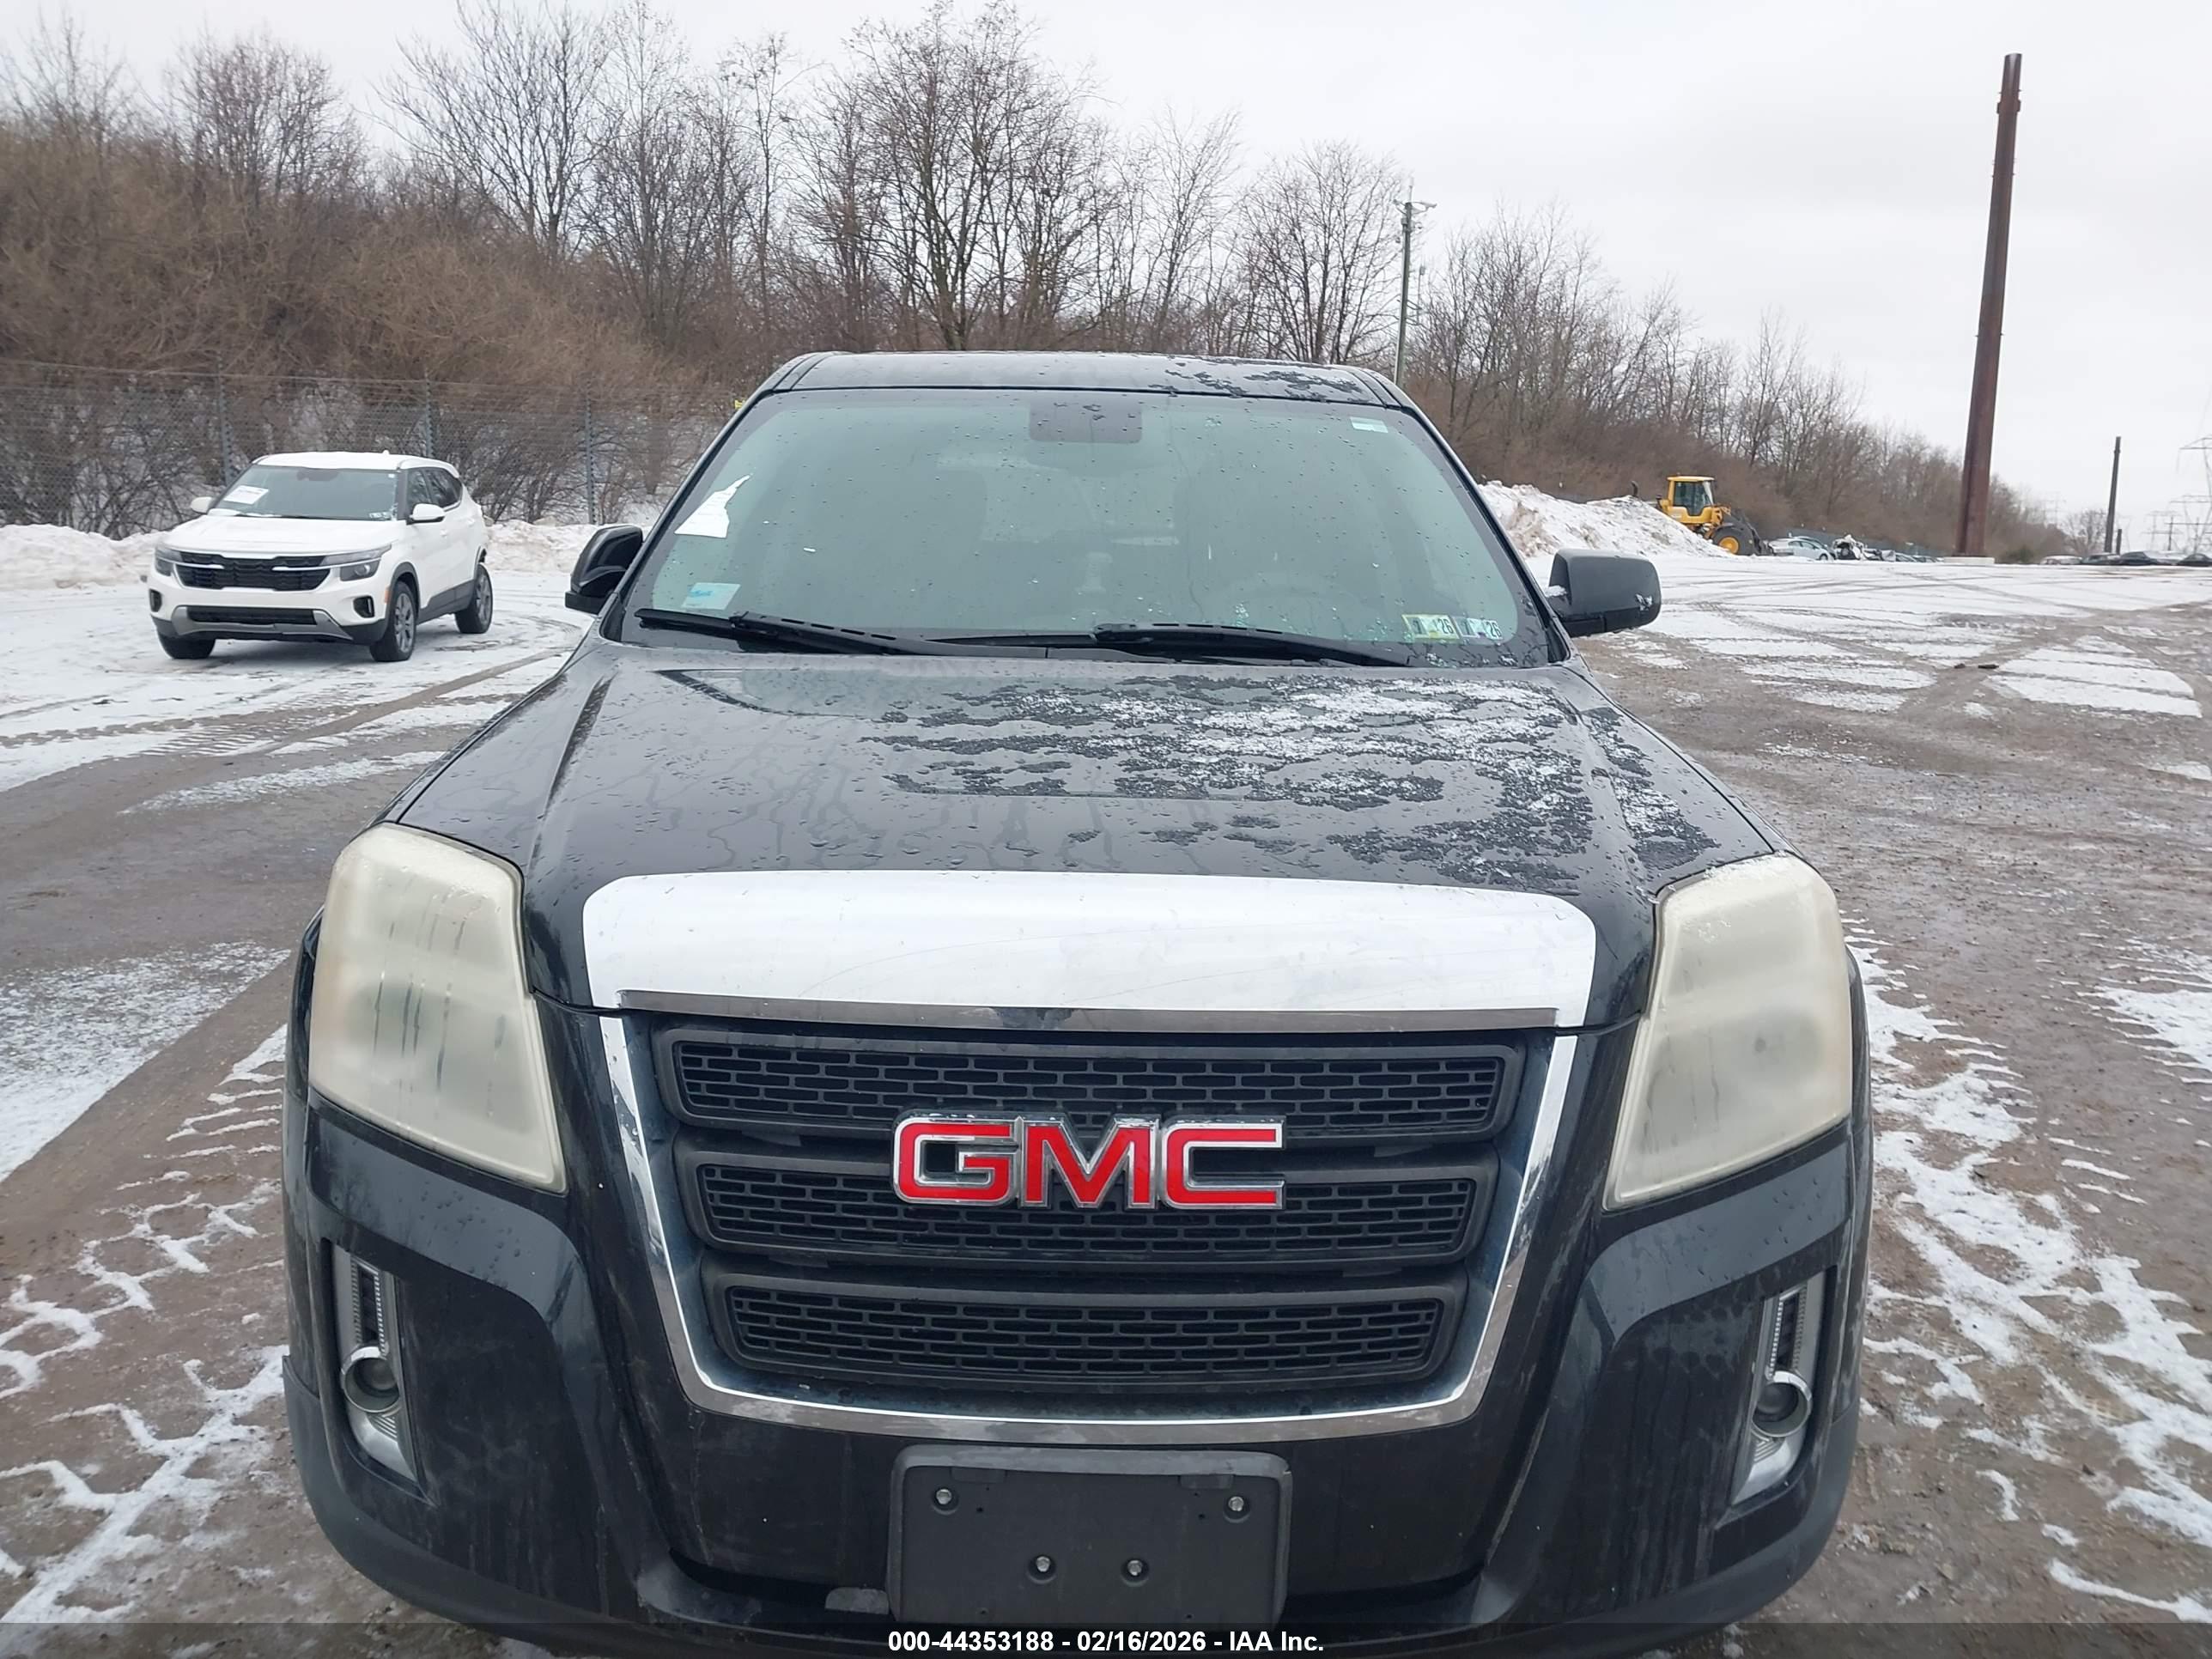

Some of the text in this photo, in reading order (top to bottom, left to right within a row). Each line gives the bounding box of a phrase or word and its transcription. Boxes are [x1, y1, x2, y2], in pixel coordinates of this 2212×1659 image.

[1437, 618, 1455, 635] 26
[1486, 621, 1502, 637] 26
[893, 1115, 1284, 1210] GMC
